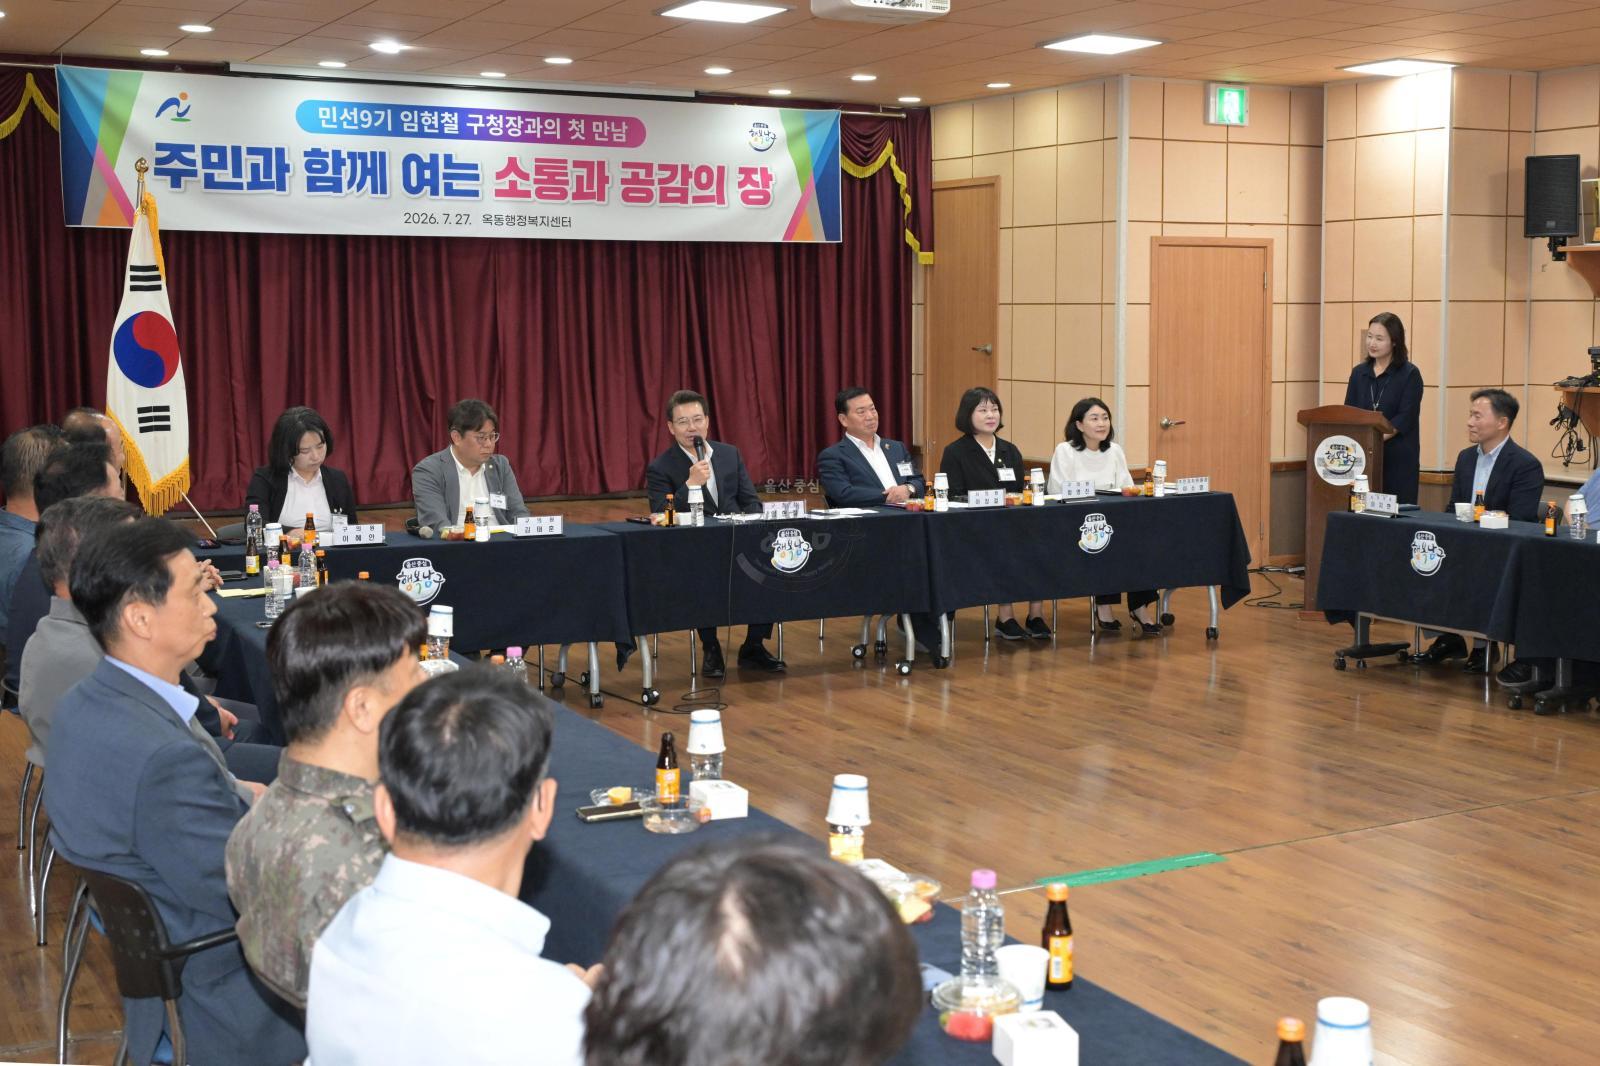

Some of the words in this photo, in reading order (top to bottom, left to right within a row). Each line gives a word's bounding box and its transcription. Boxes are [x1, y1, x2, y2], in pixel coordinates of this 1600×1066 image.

[317, 105, 394, 132] 민선9기
[400, 111, 460, 134] 임현철
[466, 114, 562, 139] 구청장과의
[568, 118, 586, 141] 첫
[592, 120, 629, 143] 만남
[153, 142, 294, 192] 주민과
[303, 147, 388, 196] 함께
[401, 152, 480, 198] 여는
[494, 155, 609, 203] 소통과
[620, 160, 725, 206] 공감의
[736, 165, 774, 207] 장
[403, 211, 440, 225] 2026.
[443, 212, 453, 225] 7.
[455, 212, 472, 226] 27.
[481, 213, 572, 229] 옥동행정복지센터
